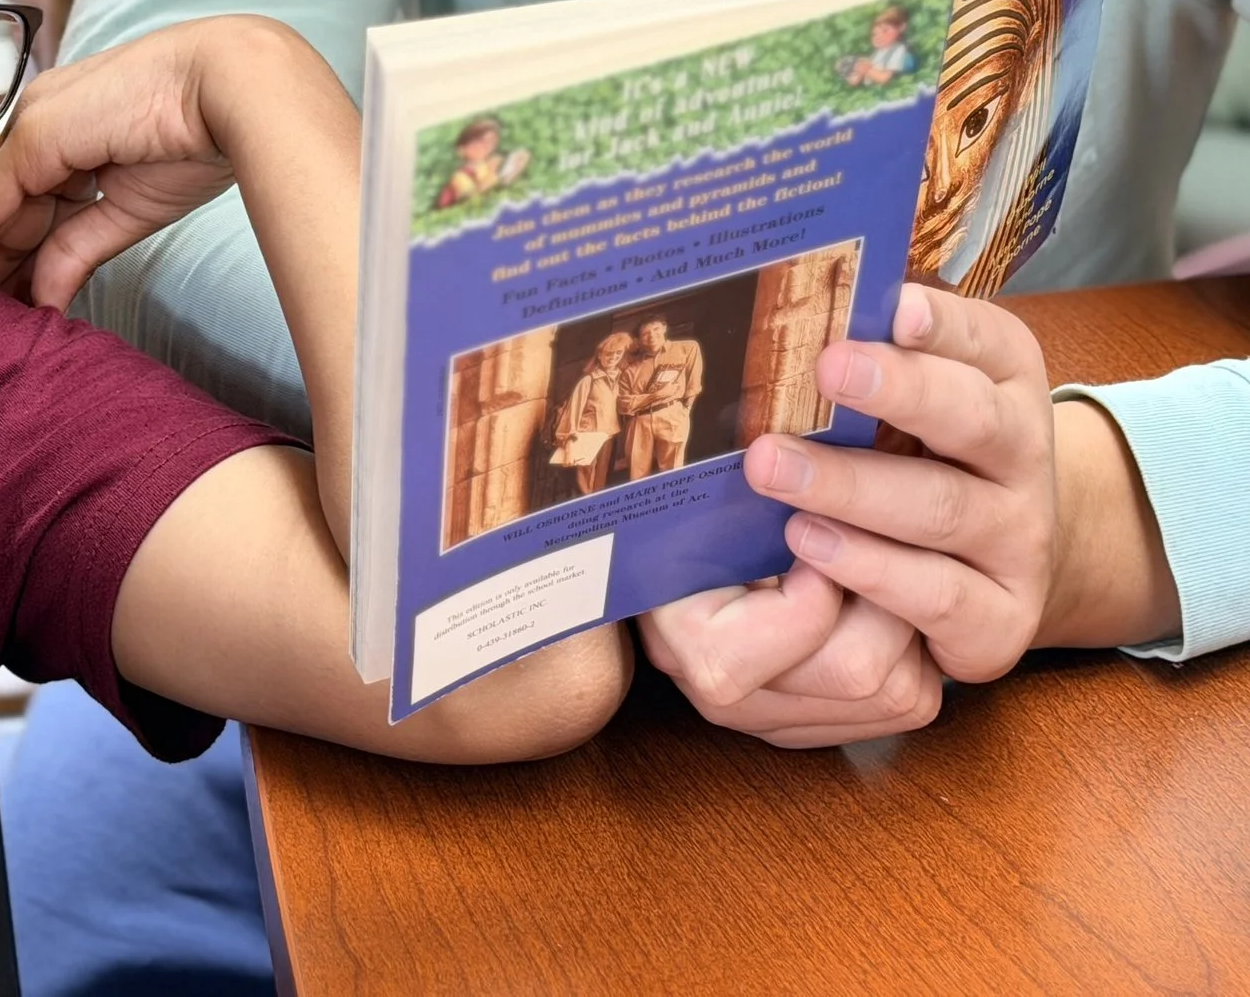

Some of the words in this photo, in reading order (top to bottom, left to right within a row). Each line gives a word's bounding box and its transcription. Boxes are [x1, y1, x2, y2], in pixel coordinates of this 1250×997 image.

[702, 46, 754, 78] NEW
[559, 149, 594, 172] for
[604, 127, 660, 160] Jack
[673, 111, 718, 142] and
[728, 84, 803, 126] Annie!
[574, 108, 628, 142] kind
[640, 97, 665, 123] of
[673, 67, 794, 115] adventure
[492, 219, 536, 241] Join
[542, 203, 591, 226] them
[597, 196, 619, 211] as
[625, 183, 667, 203] they
[672, 156, 756, 190] research
[762, 147, 793, 166] the
[799, 128, 855, 154] world
[524, 233, 547, 252] of
[551, 211, 642, 245] mummies
[647, 197, 684, 217] and
[688, 173, 776, 209] pyramids
[782, 159, 818, 180] and
[491, 260, 531, 283] find
[536, 250, 570, 269] out
[576, 240, 608, 258] the
[614, 224, 661, 247] facts
[667, 204, 732, 232] behind
[737, 195, 768, 213] the
[774, 171, 843, 203] fiction!
[501, 285, 538, 305] Fun
[545, 270, 598, 292] Facts
[619, 245, 685, 271] Photos
[707, 205, 826, 247] Illustrations
[521, 279, 629, 319] Definitions
[650, 261, 688, 282] And
[693, 246, 745, 271] Much
[751, 227, 807, 254] More!
[502, 526, 534, 543] WILL
[535, 503, 597, 530] OSBORNE
[599, 496, 621, 511] and
[623, 484, 659, 502] MARY
[661, 473, 695, 492] POPE
[698, 460, 749, 480] OSBOR
[543, 517, 619, 550] Metropolitan
[621, 503, 670, 524] Museum
[672, 496, 687, 510] of
[688, 490, 711, 505] Art.
[567, 515, 600, 531] doing
[602, 497, 652, 519] research
[655, 493, 667, 504] at
[670, 487, 689, 501] the
[433, 612, 478, 641] distribution
[479, 598, 511, 619] through
[512, 590, 526, 603] the
[527, 580, 554, 596] school
[447, 610, 465, 624] This
[465, 595, 493, 615] edition
[504, 585, 522, 600] only
[523, 569, 561, 589] available
[562, 563, 576, 576] for
[466, 608, 528, 640] SCHOLASTIC
[476, 620, 535, 653] 0-439-31860-2
